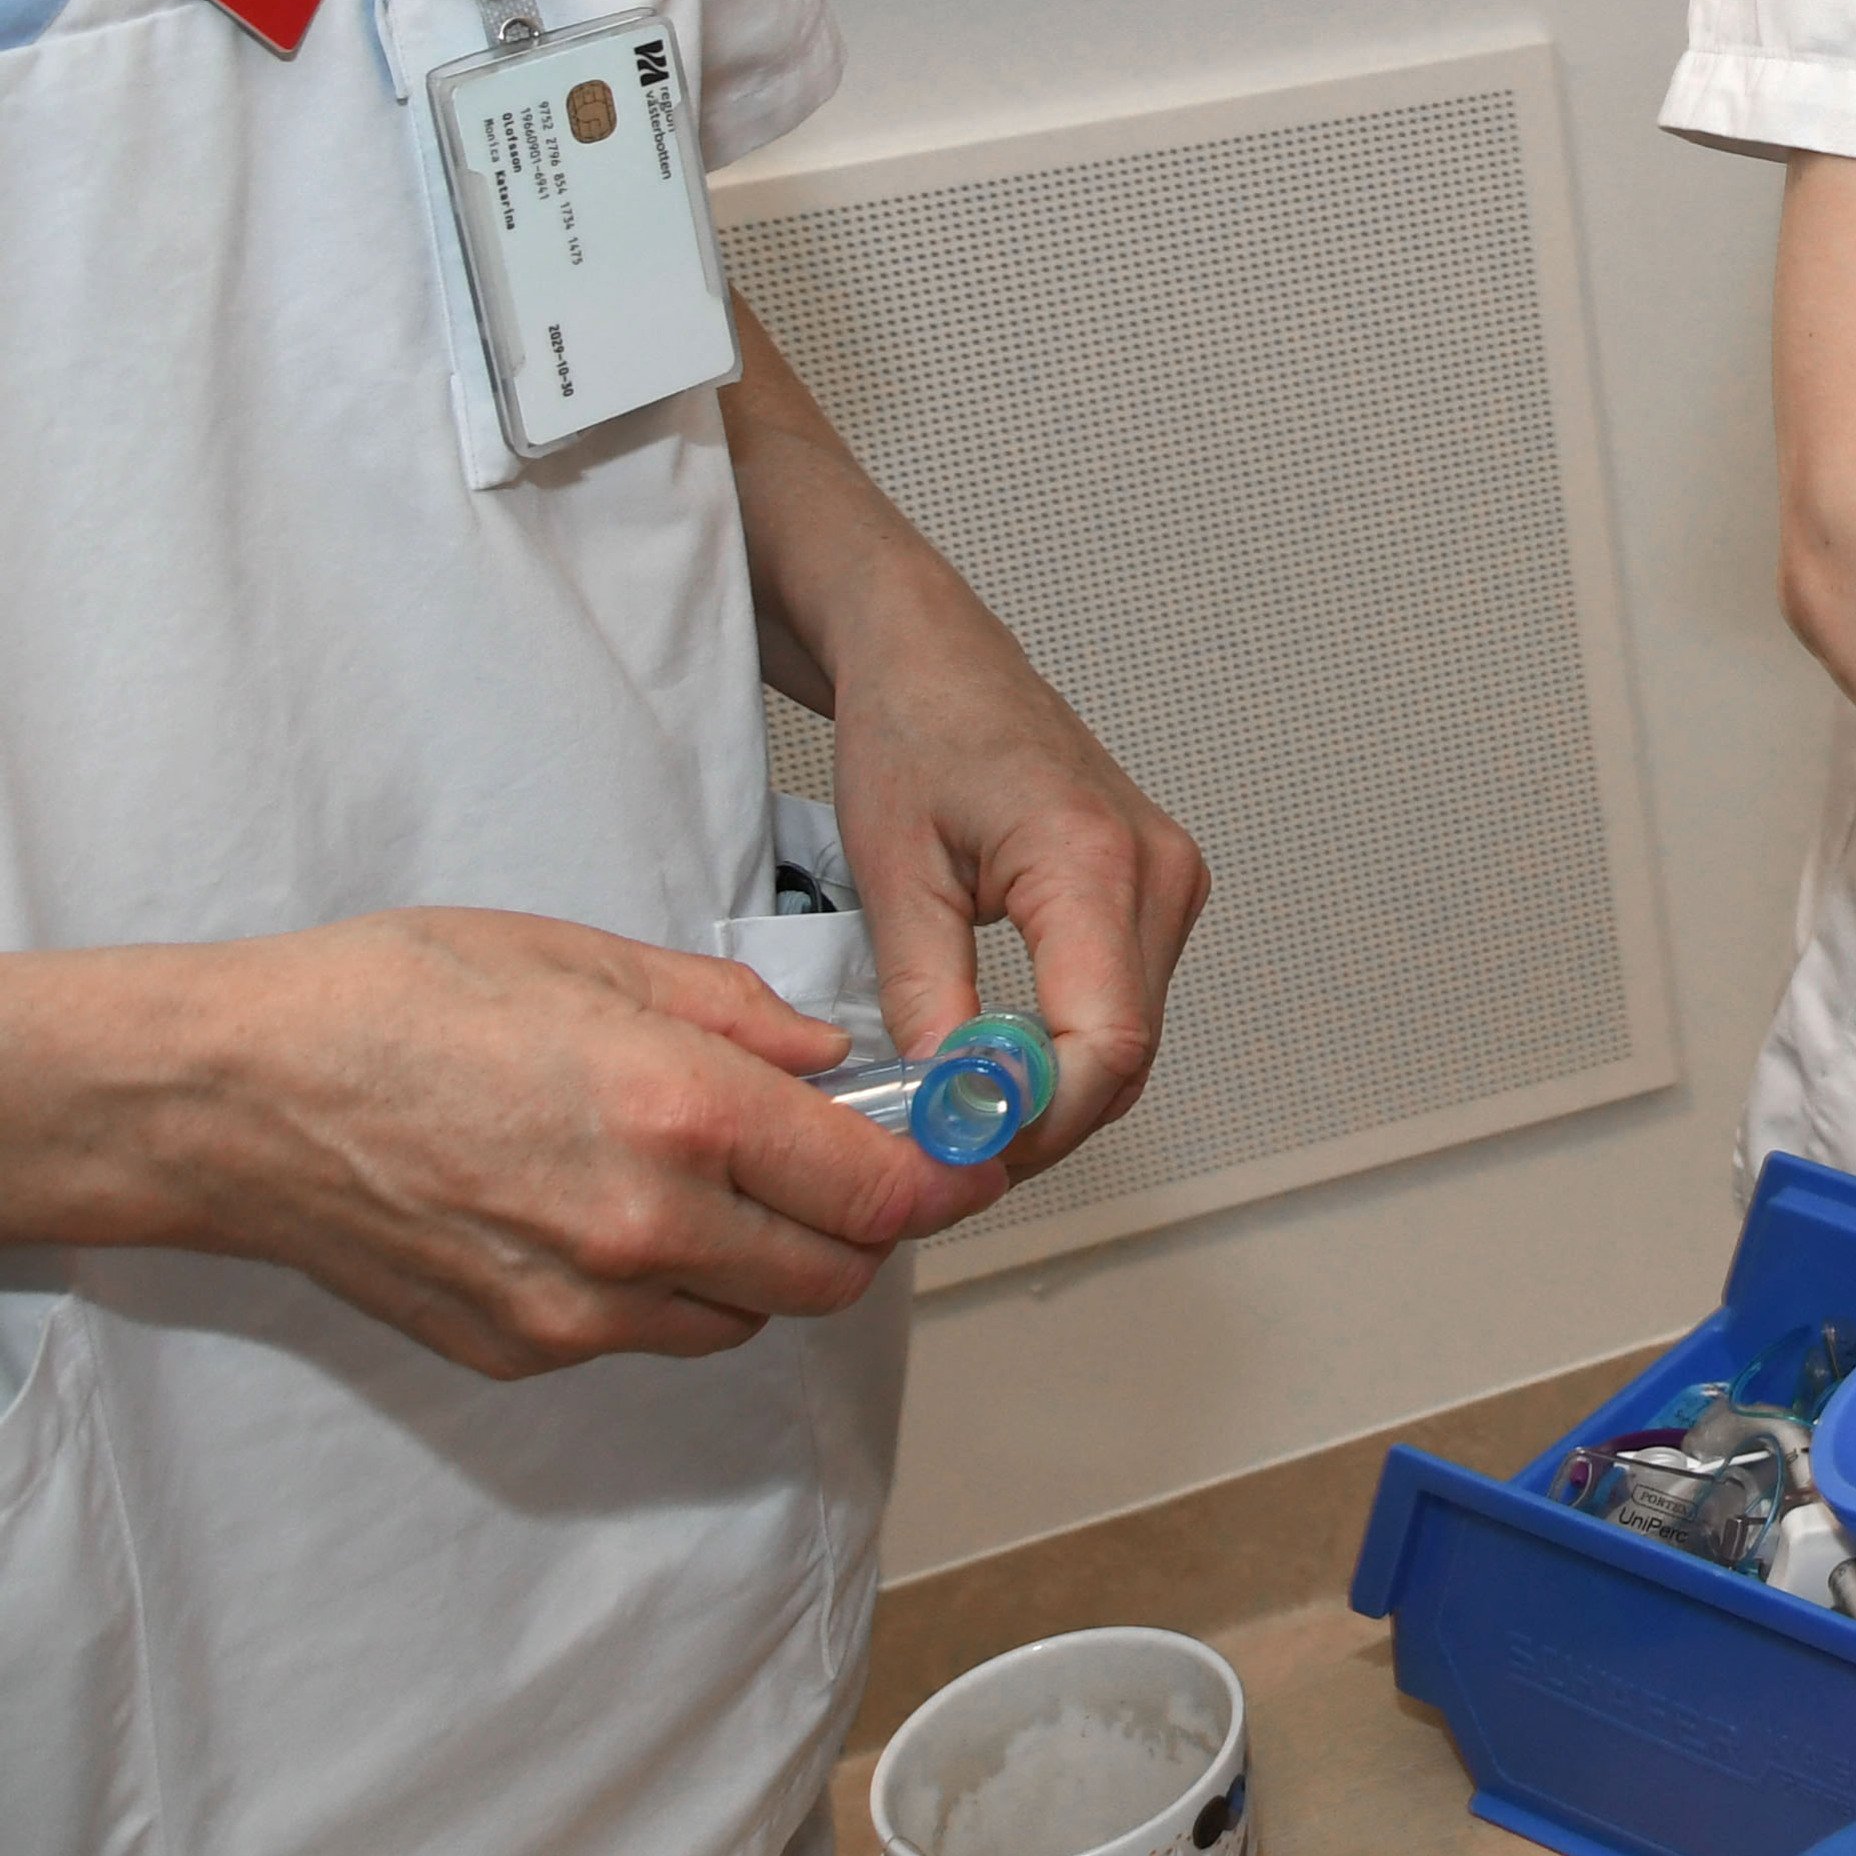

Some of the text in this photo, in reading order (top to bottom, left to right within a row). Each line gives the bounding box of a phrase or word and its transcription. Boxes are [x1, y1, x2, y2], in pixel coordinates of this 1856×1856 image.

[483, 117, 516, 232] Monica Katarina
[501, 111, 523, 174] Olofsson
[520, 106, 550, 201] 19660901-6941
[645, 89, 673, 181] västerbotten
[538, 100, 584, 266] 9752 2796 854 1734 1475
[547, 323, 575, 398] 2029-10-30
[1617, 1505, 1690, 1545] UniPerc
